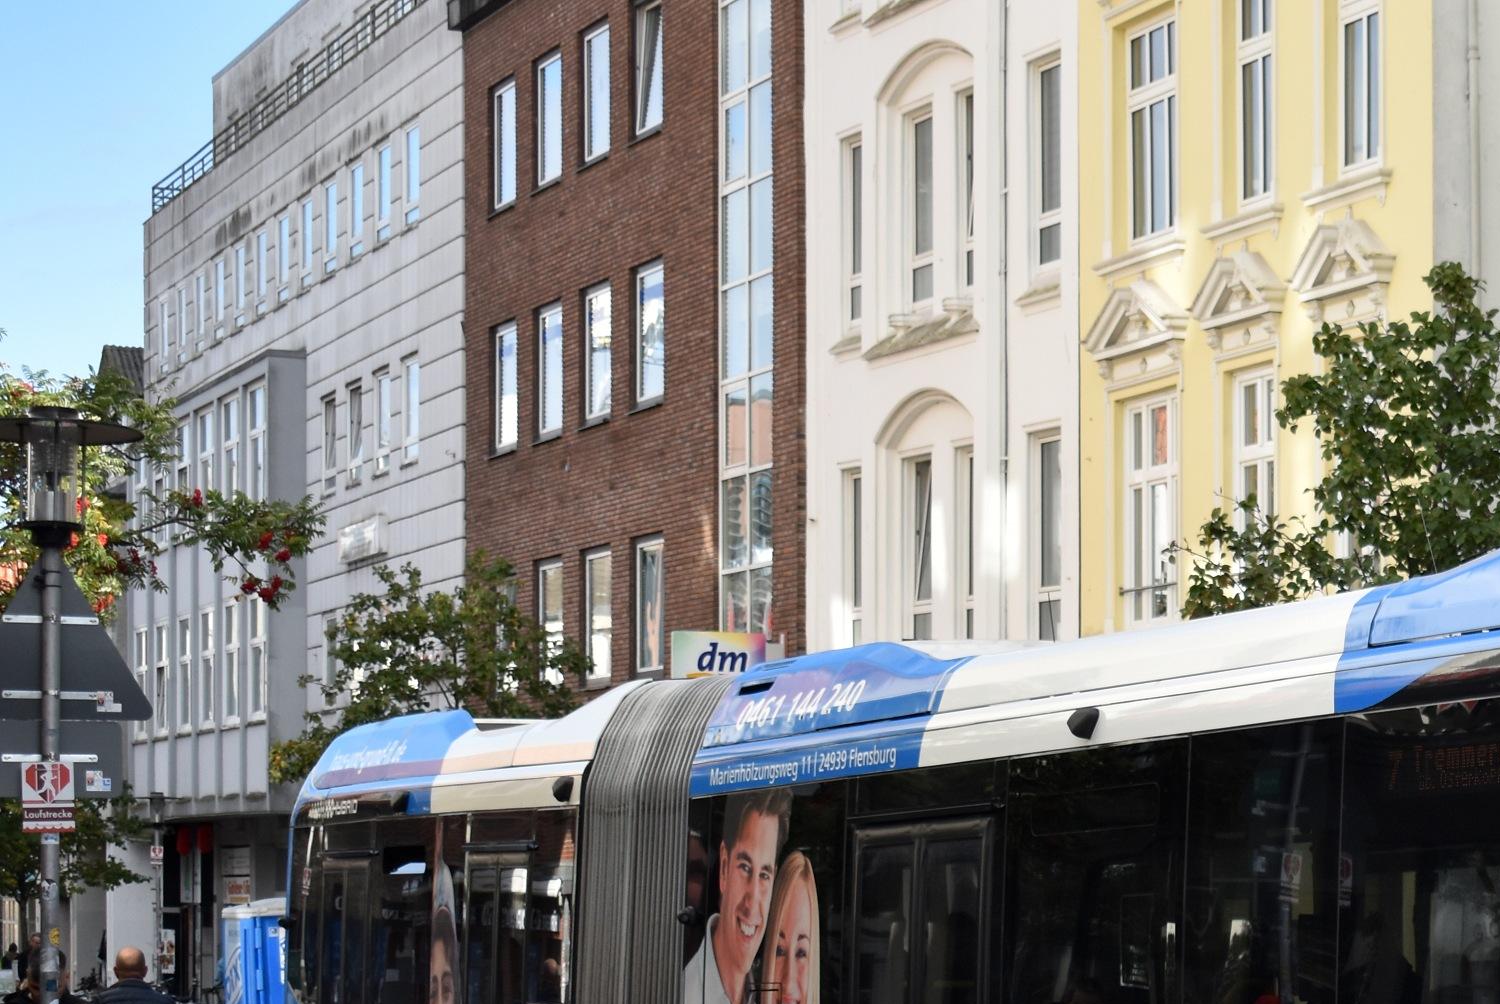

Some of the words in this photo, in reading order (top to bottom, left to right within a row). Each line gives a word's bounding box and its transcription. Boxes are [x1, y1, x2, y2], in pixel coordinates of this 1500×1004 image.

[697, 643, 748, 672] dm
[736, 695, 786, 731] 0461
[788, 687, 823, 722] 144
[821, 680, 866, 715] 240
[710, 761, 798, 787] Marienhölzungsweg
[802, 757, 812, 775] 11
[819, 750, 847, 772] 24939
[849, 745, 897, 768] Flensburg
[24, 808, 73, 819] Laufstrecke
